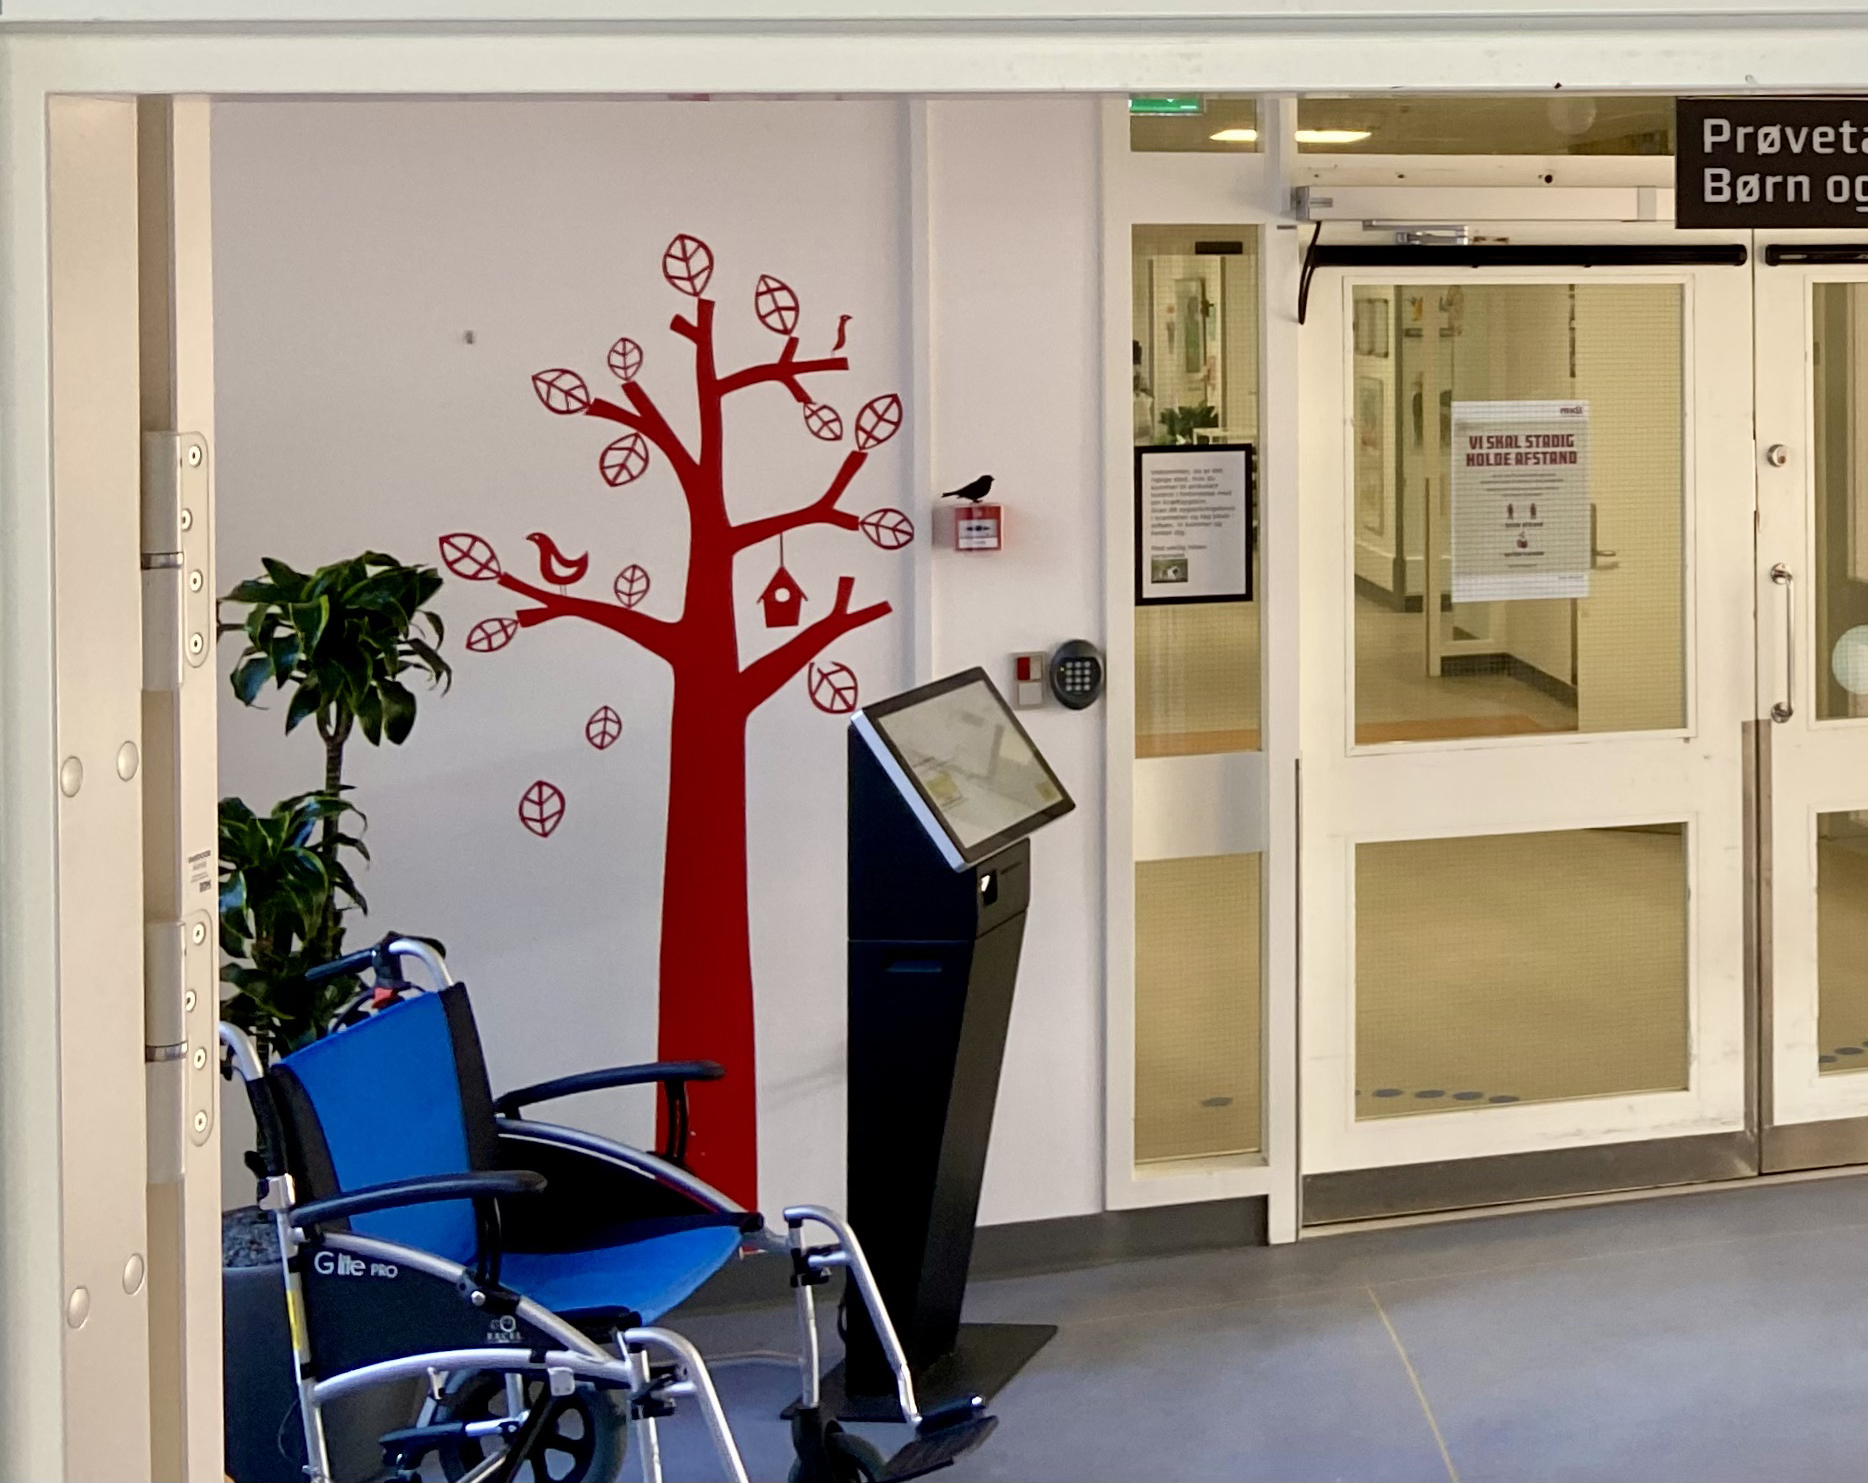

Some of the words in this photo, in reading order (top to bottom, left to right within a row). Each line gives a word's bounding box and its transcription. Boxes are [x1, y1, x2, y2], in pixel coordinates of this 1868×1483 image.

[1703, 168, 1811, 205] Børn
[1469, 435, 1482, 450] VI
[1487, 434, 1521, 449] SKAL
[1525, 433, 1574, 448] STADIG
[1466, 452, 1512, 467] HOLDE
[1515, 451, 1577, 466] AFSTAND
[370, 1264, 398, 1279] PRO
